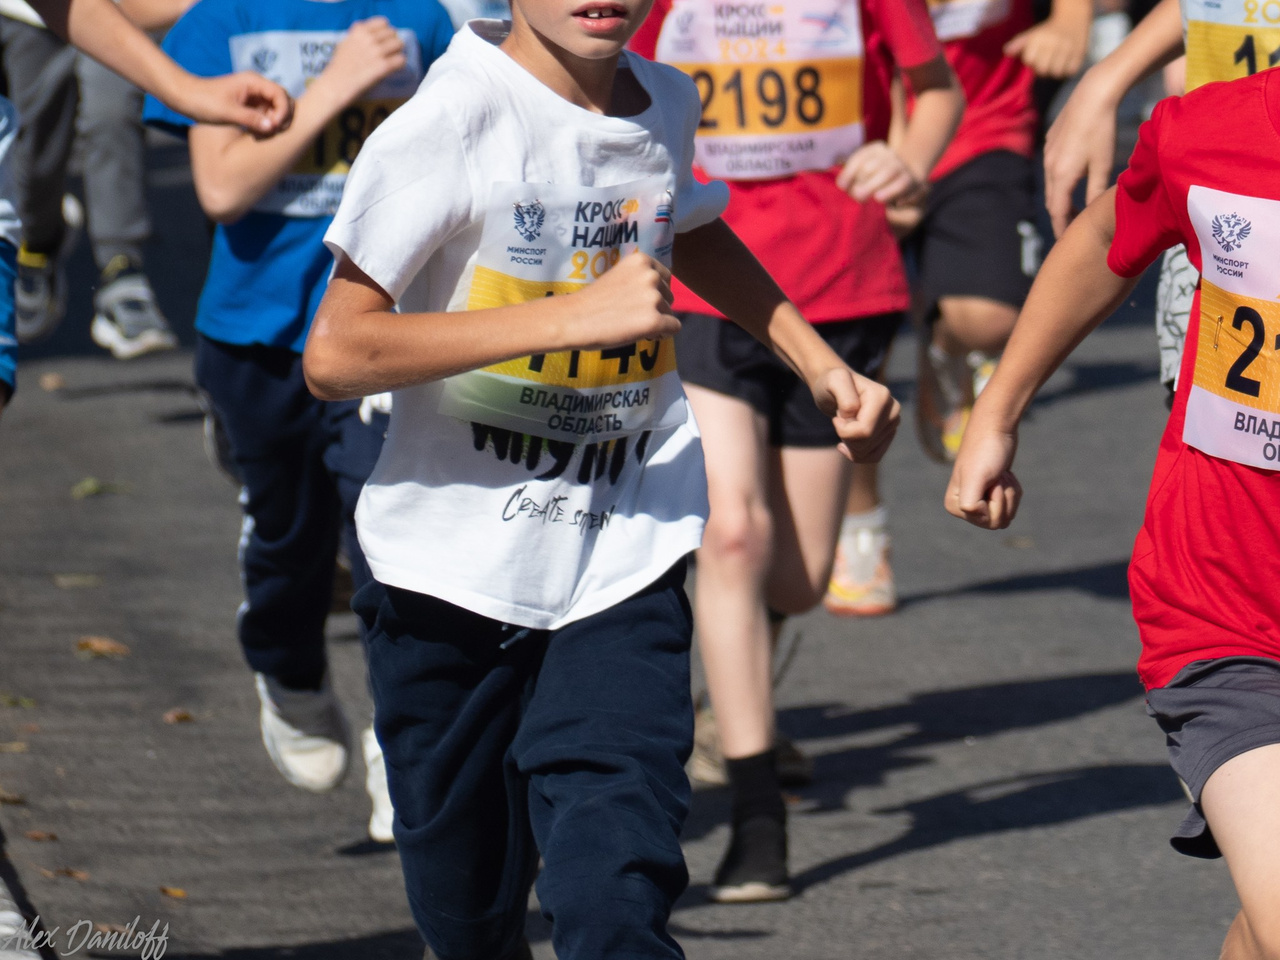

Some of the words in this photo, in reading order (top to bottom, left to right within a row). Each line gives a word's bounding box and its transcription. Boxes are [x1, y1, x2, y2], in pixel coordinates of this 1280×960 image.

[715, 21, 783, 38] НАЦИИ
[718, 39, 787, 61] 2024
[694, 66, 826, 130] 2198
[574, 198, 626, 223] КРОСС
[571, 221, 639, 248] НАЦИИ
[507, 246, 547, 256] МИНСПОРТ
[510, 256, 543, 266] РОССИИ
[520, 386, 650, 414] ВЛАДИМИРСКАЯ
[547, 414, 623, 434] ОБЛАСТЬ
